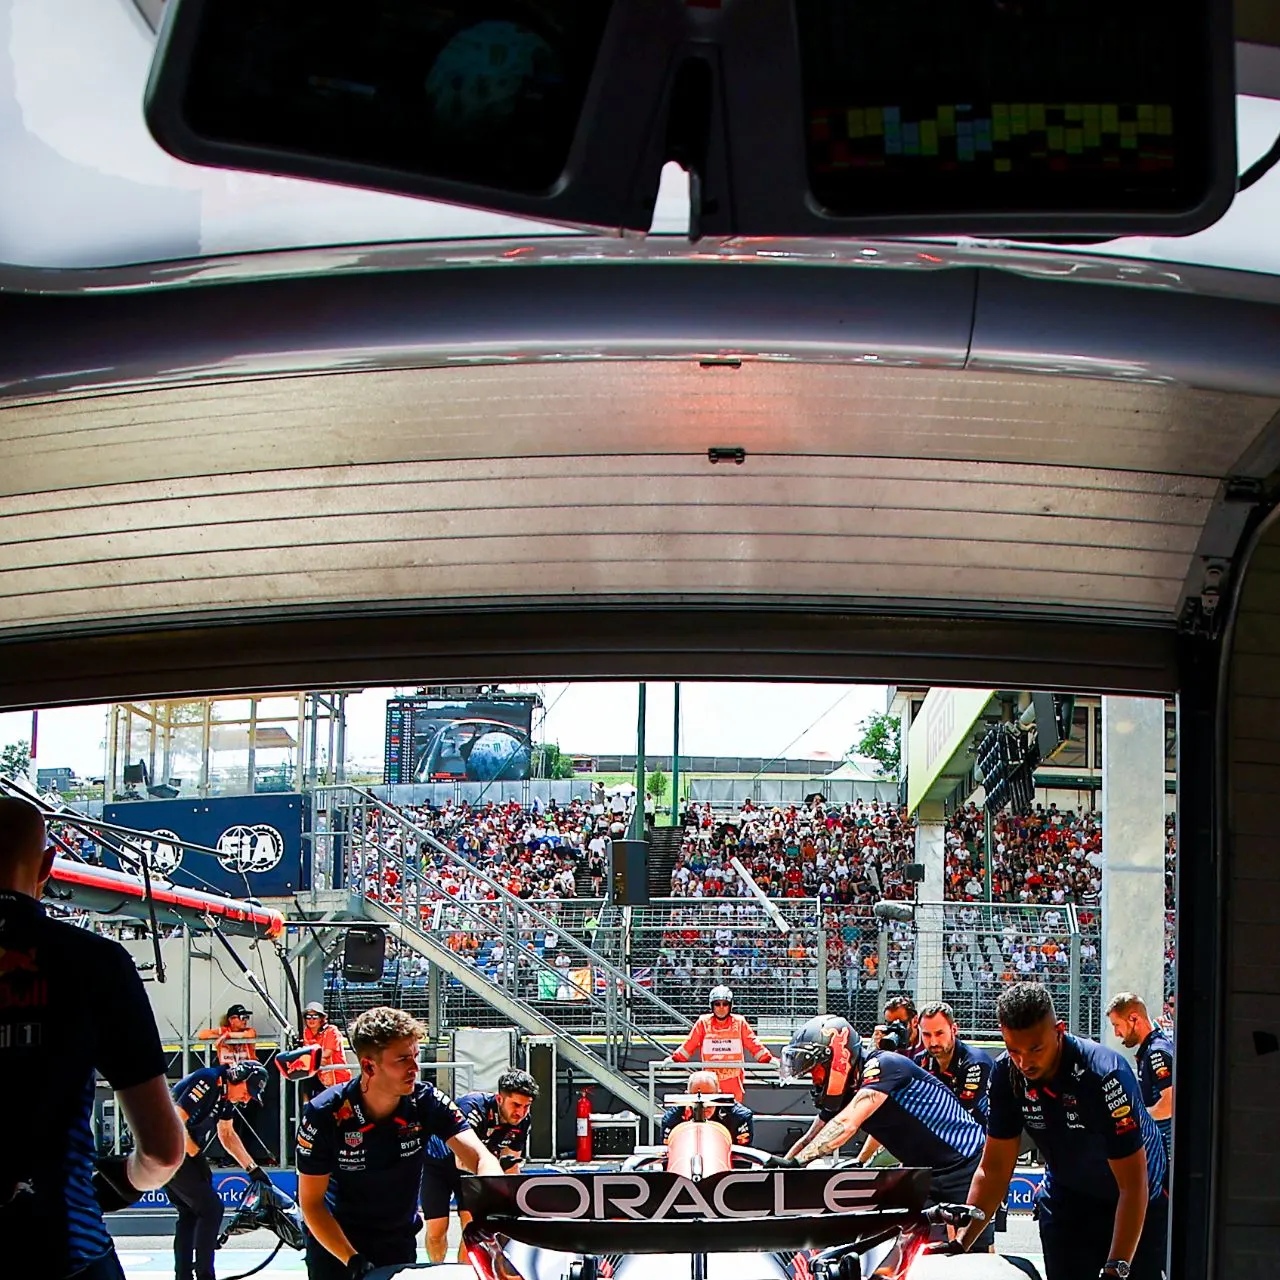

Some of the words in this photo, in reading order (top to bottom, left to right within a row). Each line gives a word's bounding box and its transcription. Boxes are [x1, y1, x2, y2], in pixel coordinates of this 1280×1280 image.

[1102, 1077, 1120, 1092] VISA
[1107, 1093, 1129, 1111] ROKT
[516, 1171, 880, 1220] ORACLE
